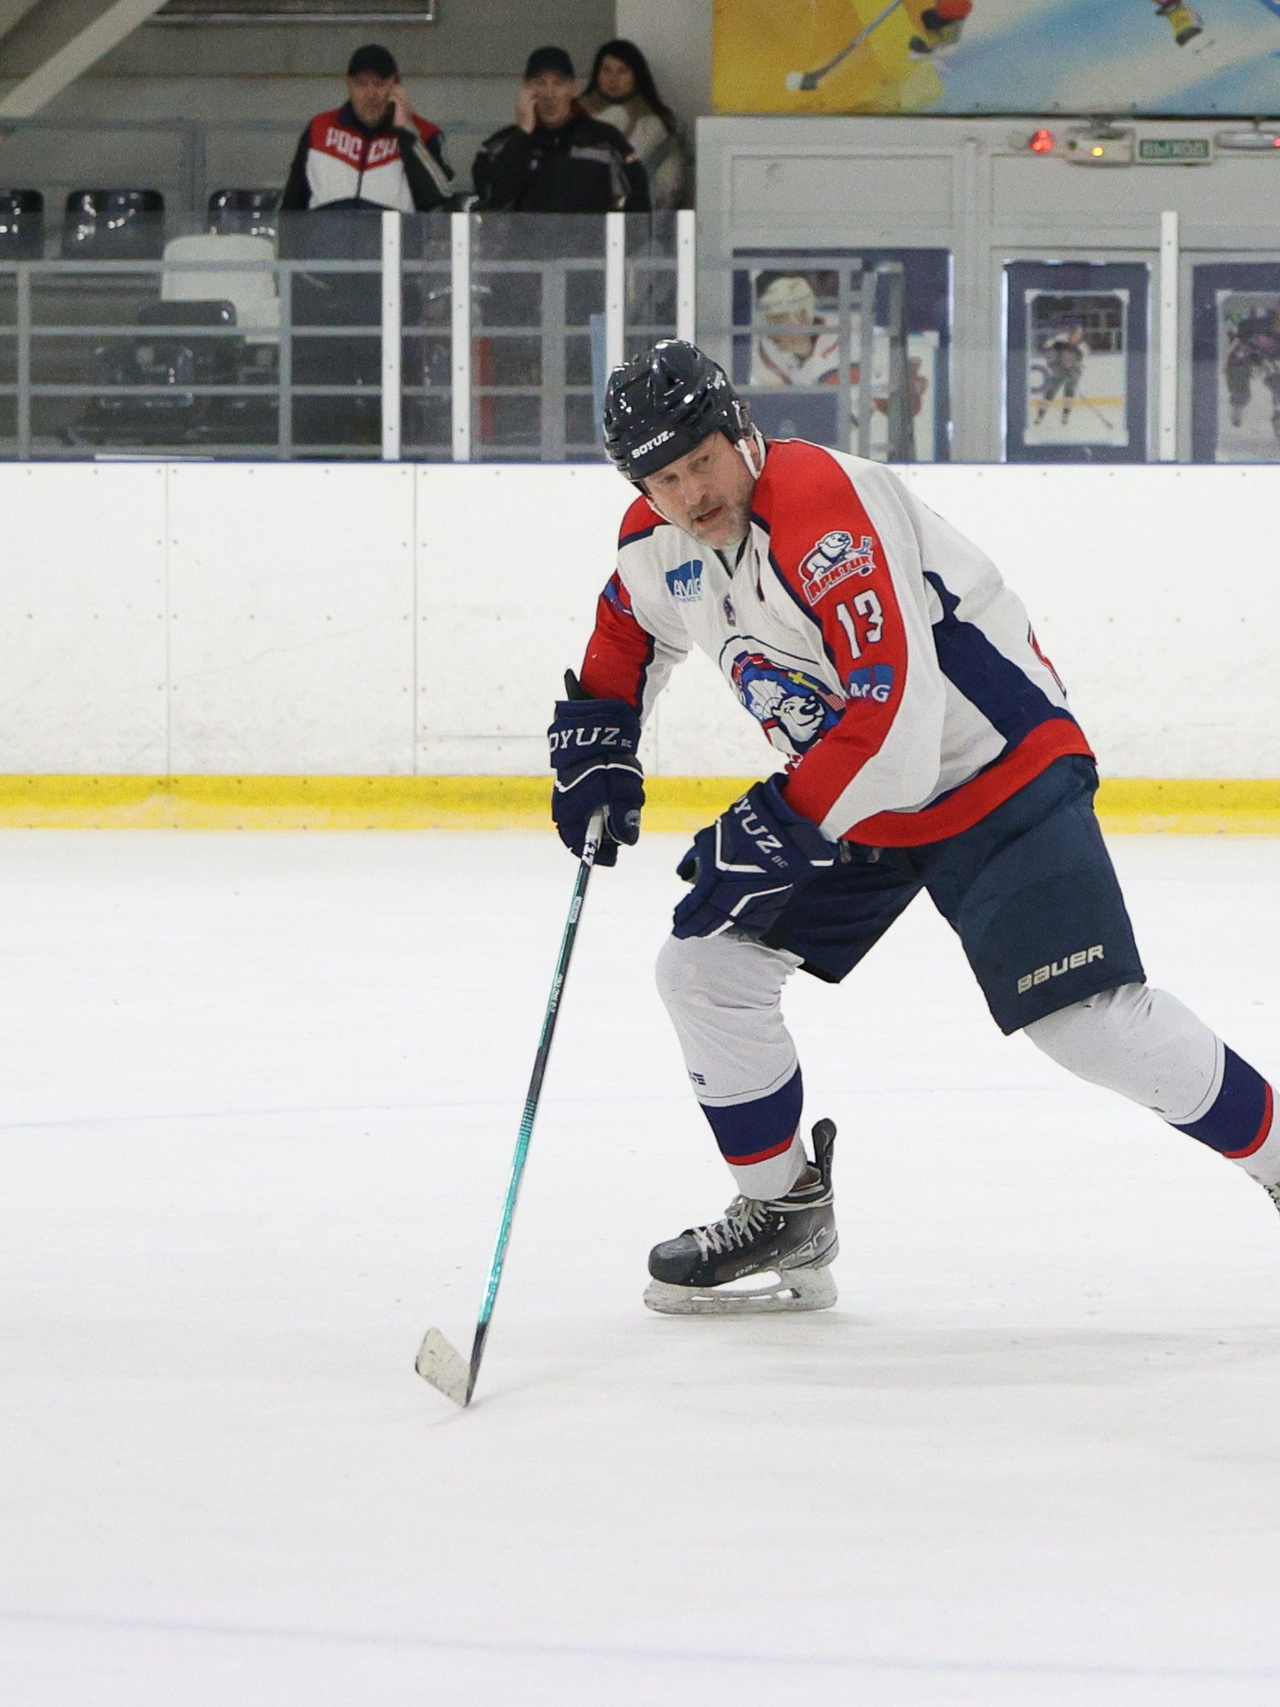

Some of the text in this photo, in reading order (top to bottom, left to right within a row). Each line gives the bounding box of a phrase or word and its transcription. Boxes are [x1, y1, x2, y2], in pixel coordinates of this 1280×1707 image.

[631, 430, 670, 459] SOYUZ
[836, 588, 885, 660] 13
[847, 682, 892, 703] MG
[549, 726, 620, 753] OYUZ
[734, 794, 784, 855] YUZ
[1017, 944, 1105, 995] BAUER
